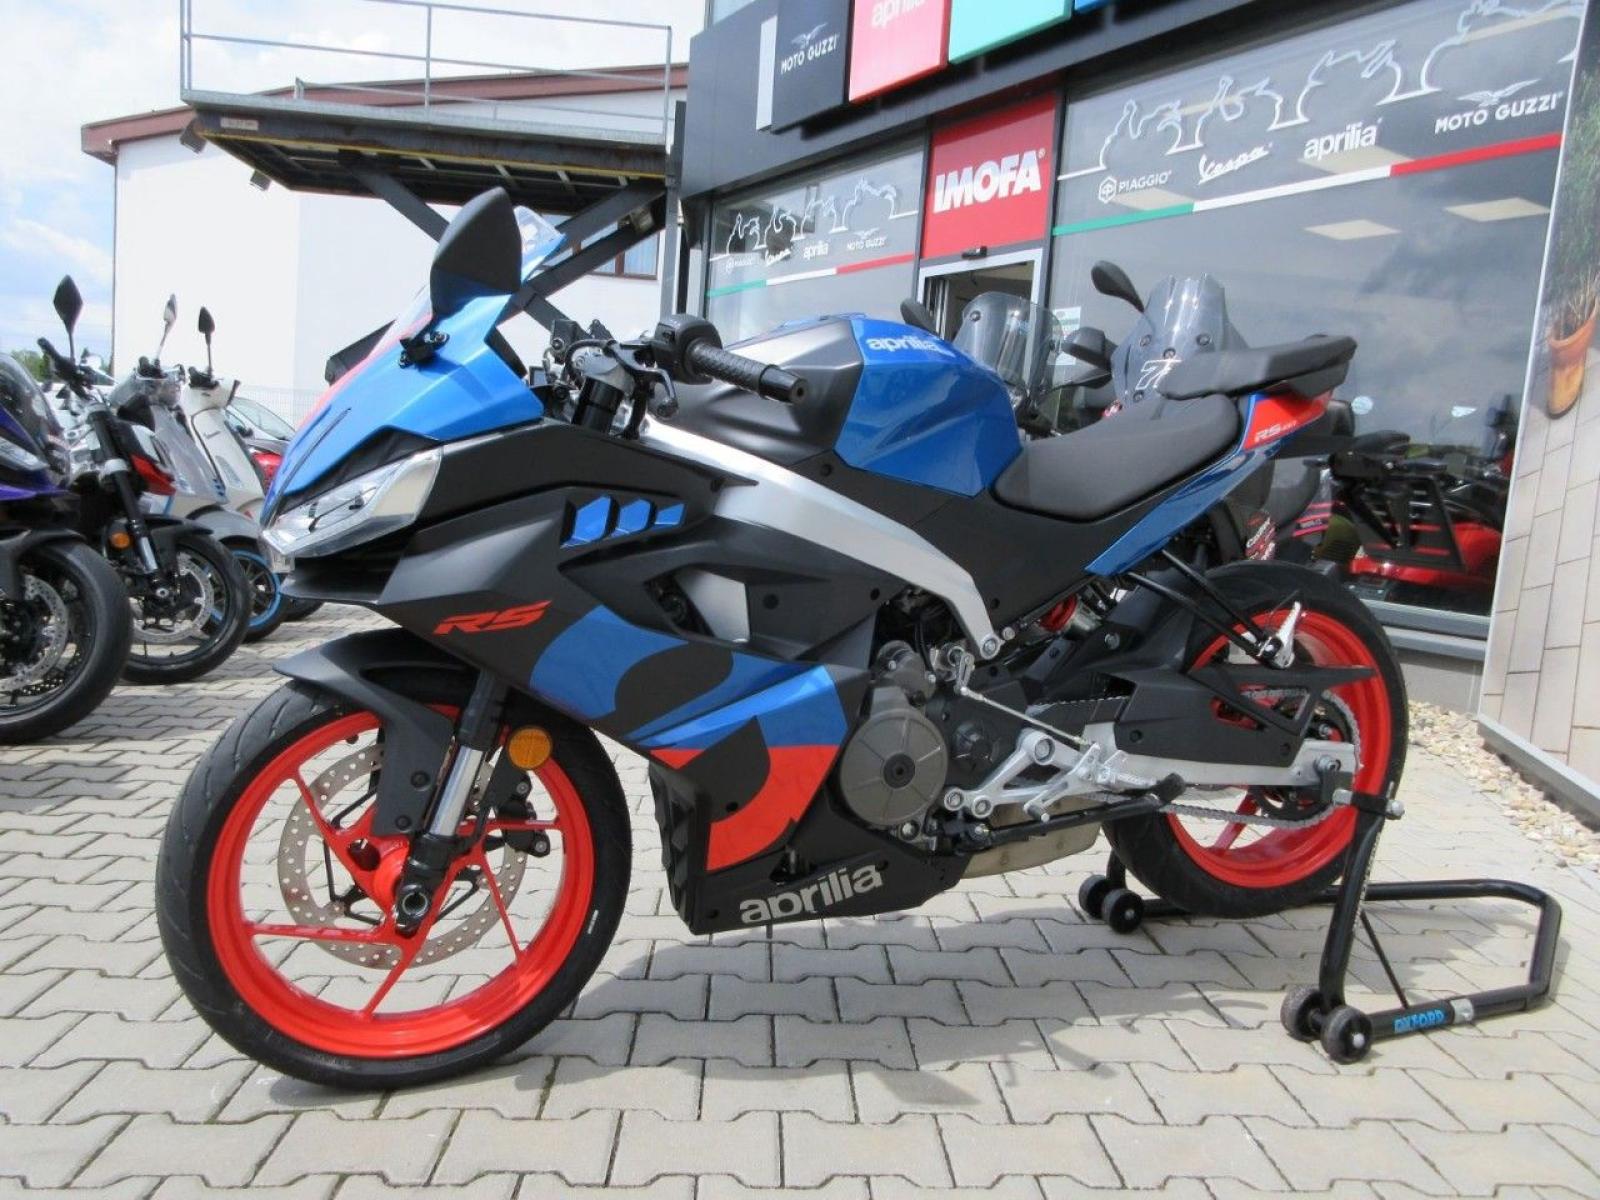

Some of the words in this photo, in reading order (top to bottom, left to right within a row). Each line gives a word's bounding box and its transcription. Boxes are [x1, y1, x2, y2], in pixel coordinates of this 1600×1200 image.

[781, 51, 805, 75] MOTO
[807, 37, 838, 66] GUZZI
[1434, 109, 1488, 134] MOTO
[1494, 93, 1558, 121] GUZZI
[1304, 124, 1378, 161] aprilia
[1118, 172, 1170, 193] PIAGGIO
[1198, 148, 1270, 186] Vespa
[433, 599, 552, 635] RS
[739, 864, 884, 925] aprilia
